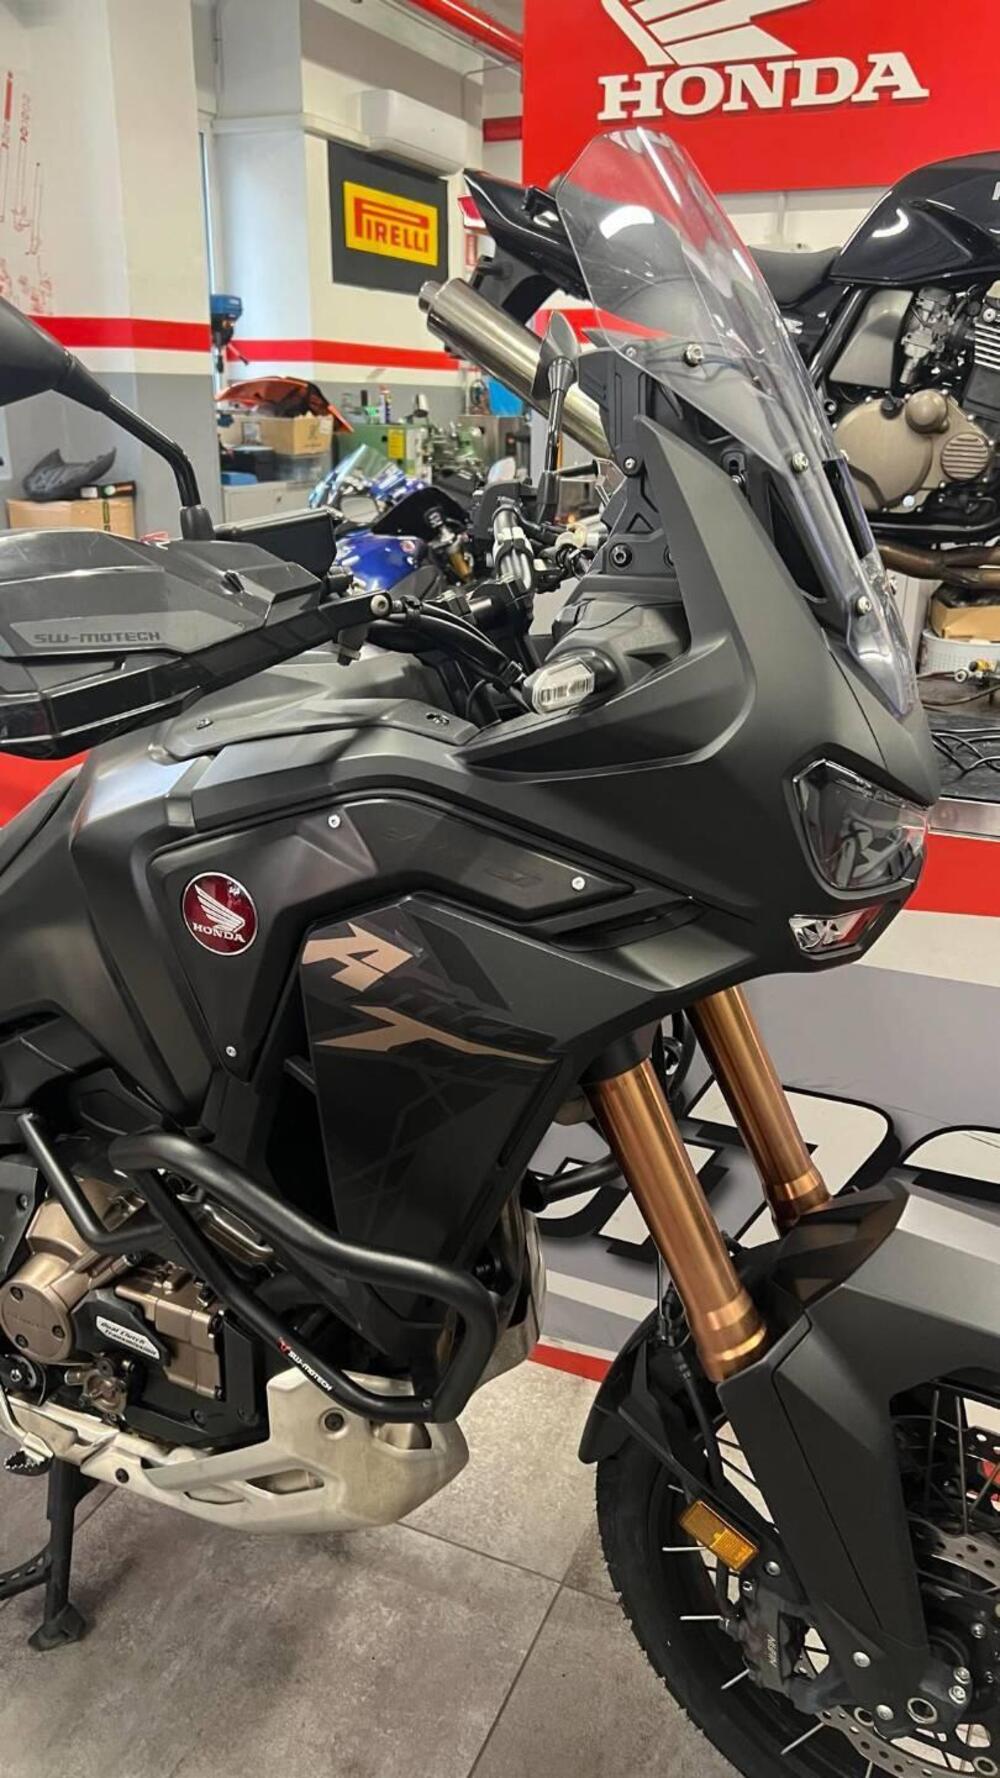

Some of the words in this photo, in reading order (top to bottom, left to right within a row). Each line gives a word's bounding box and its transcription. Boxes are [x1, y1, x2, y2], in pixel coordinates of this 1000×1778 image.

[597, 51, 930, 121] HONDA
[353, 197, 430, 253] PIRELLI
[34, 631, 161, 644] SW-MOTECH
[192, 922, 246, 943] HONDA
[288, 1350, 333, 1391] SW-MOTECH
